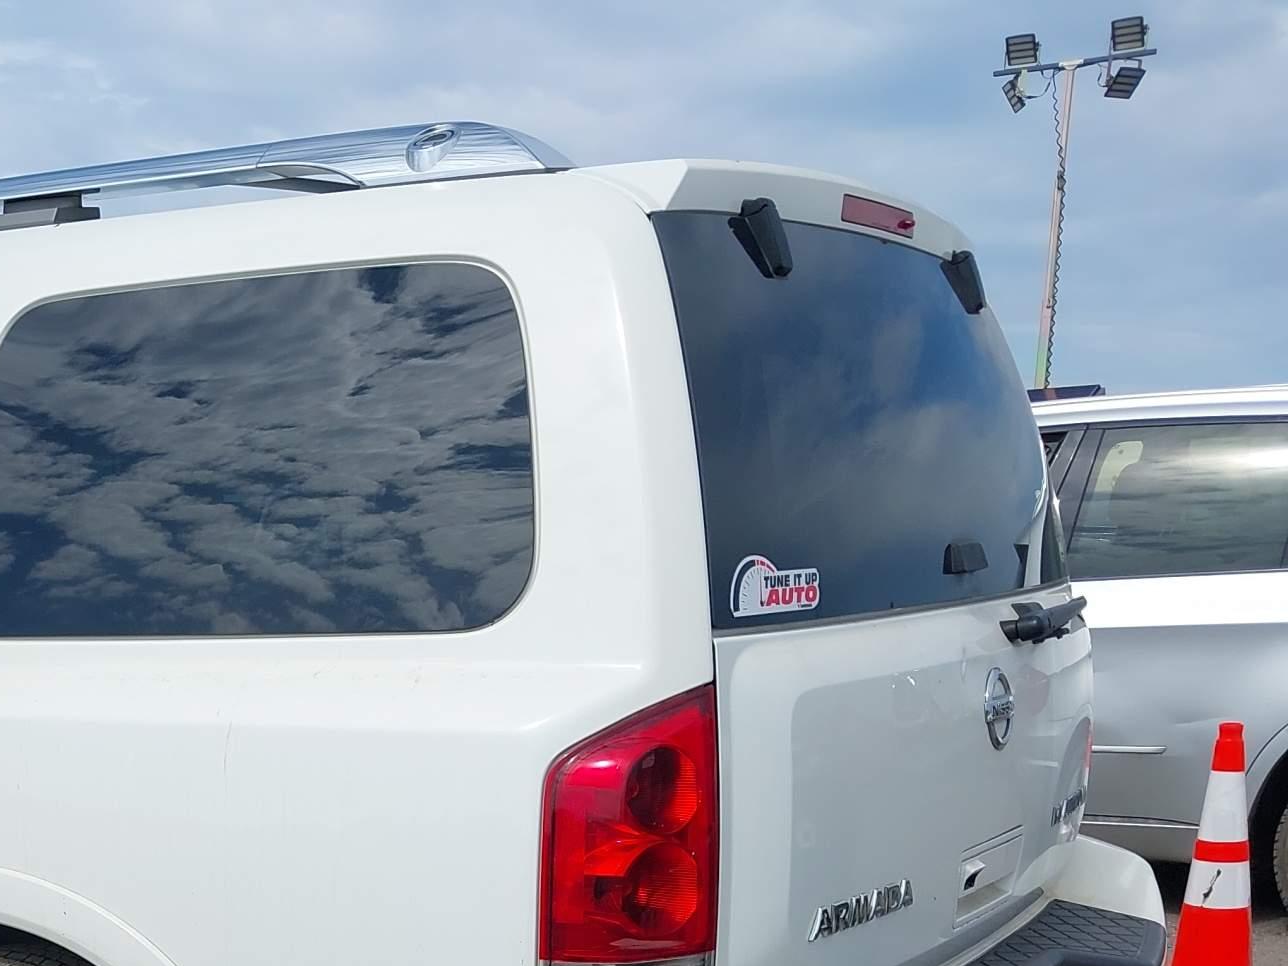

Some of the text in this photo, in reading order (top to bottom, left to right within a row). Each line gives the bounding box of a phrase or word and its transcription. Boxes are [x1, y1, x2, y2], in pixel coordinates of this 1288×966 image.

[763, 572, 818, 589] TUNE IT UP
[765, 585, 818, 607] AUTO
[808, 879, 913, 942] ARMADA
